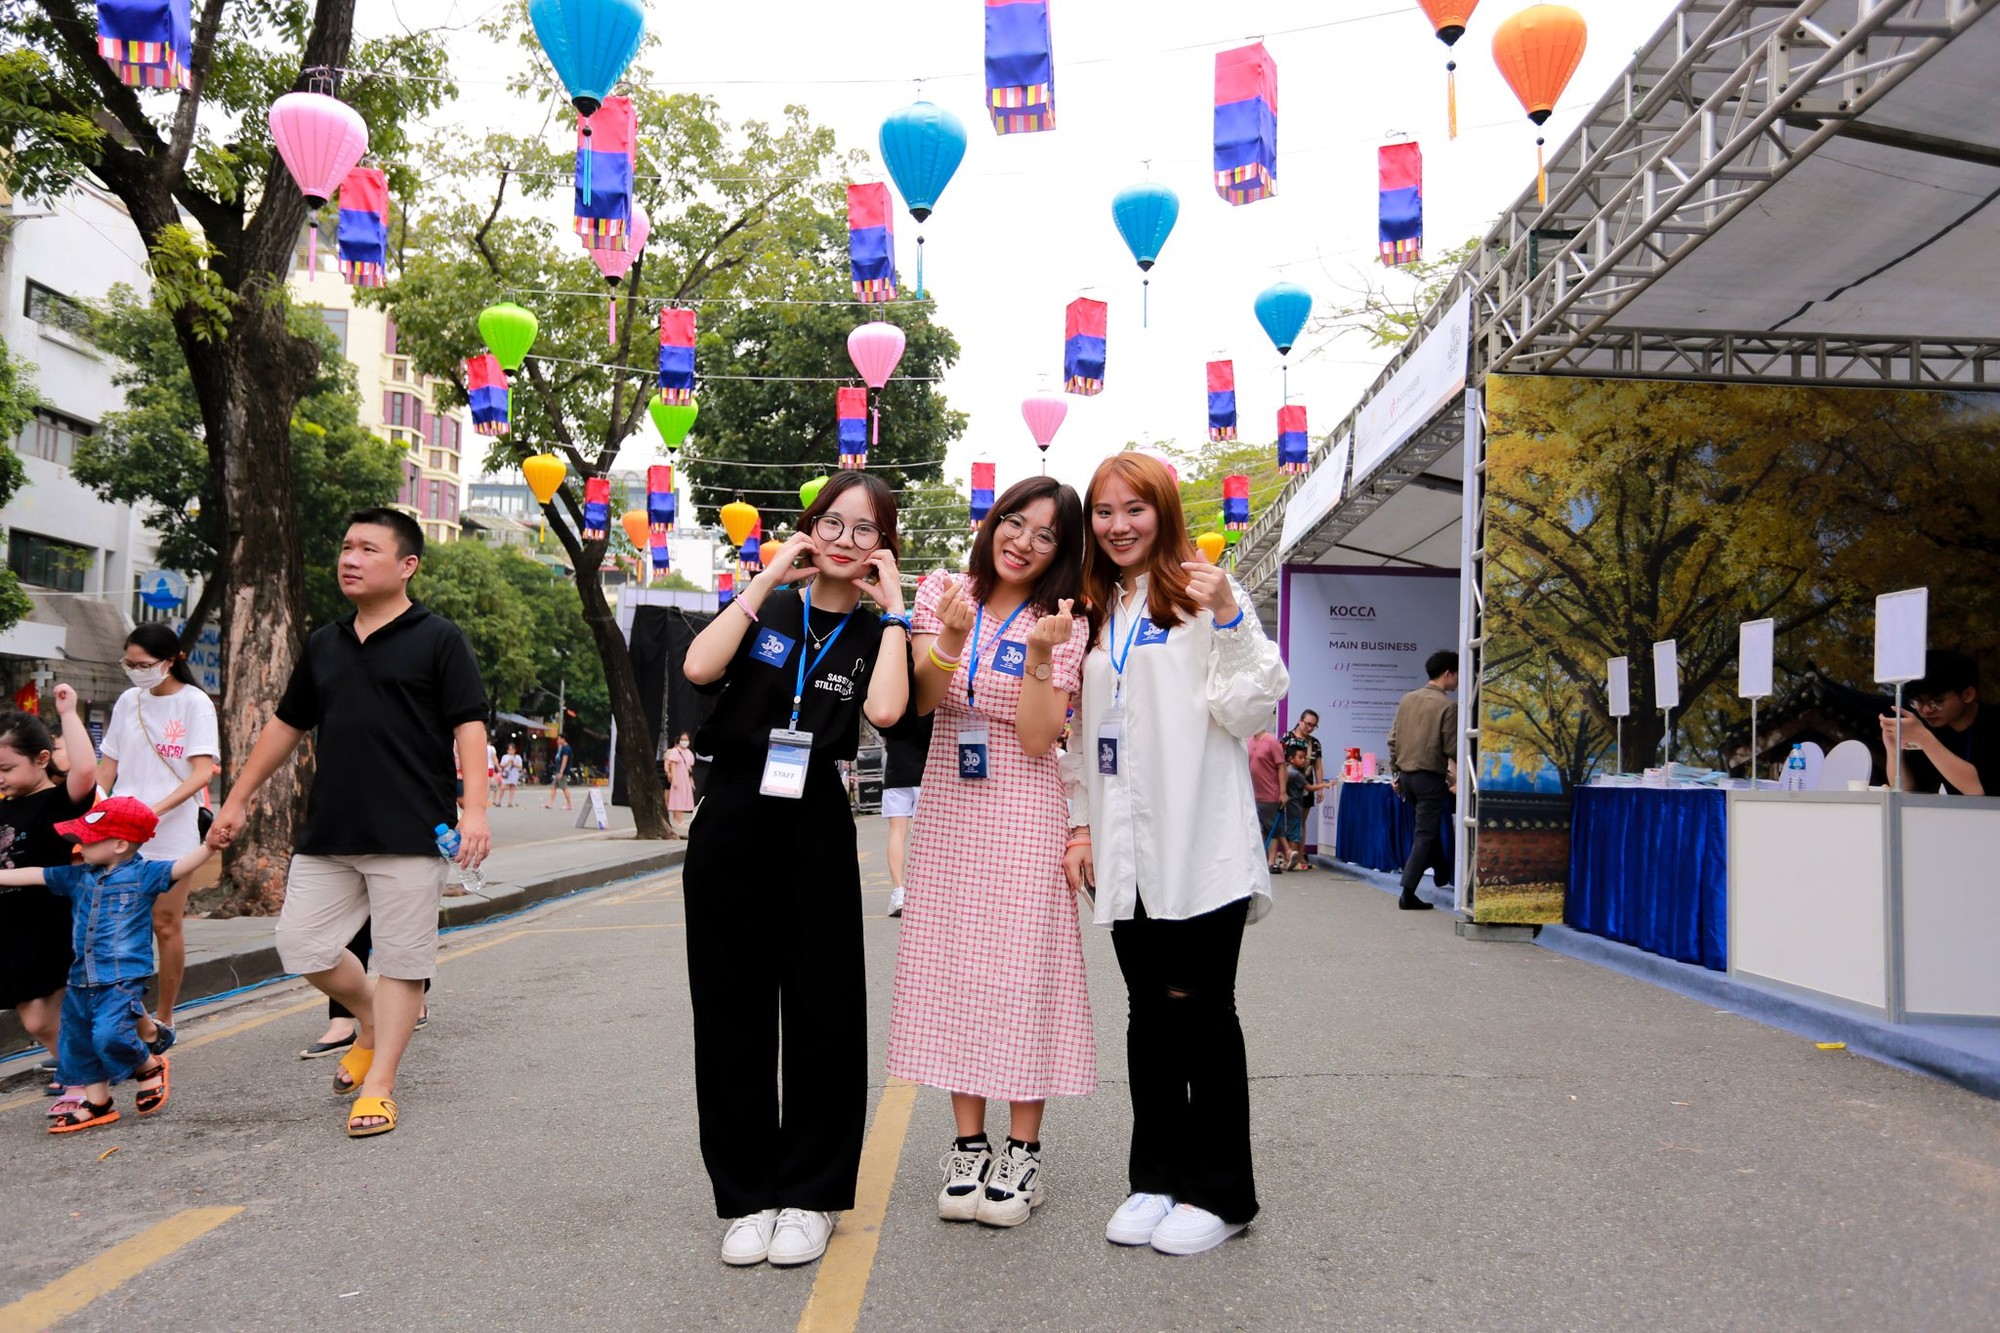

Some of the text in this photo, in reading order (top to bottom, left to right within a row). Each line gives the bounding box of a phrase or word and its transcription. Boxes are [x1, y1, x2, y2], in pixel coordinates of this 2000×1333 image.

[1329, 605, 1376, 617] KOCCA
[1329, 640, 1418, 652] MAIN BUSINESS
[814, 680, 834, 690] STILL
[773, 770, 797, 780] STAFF
